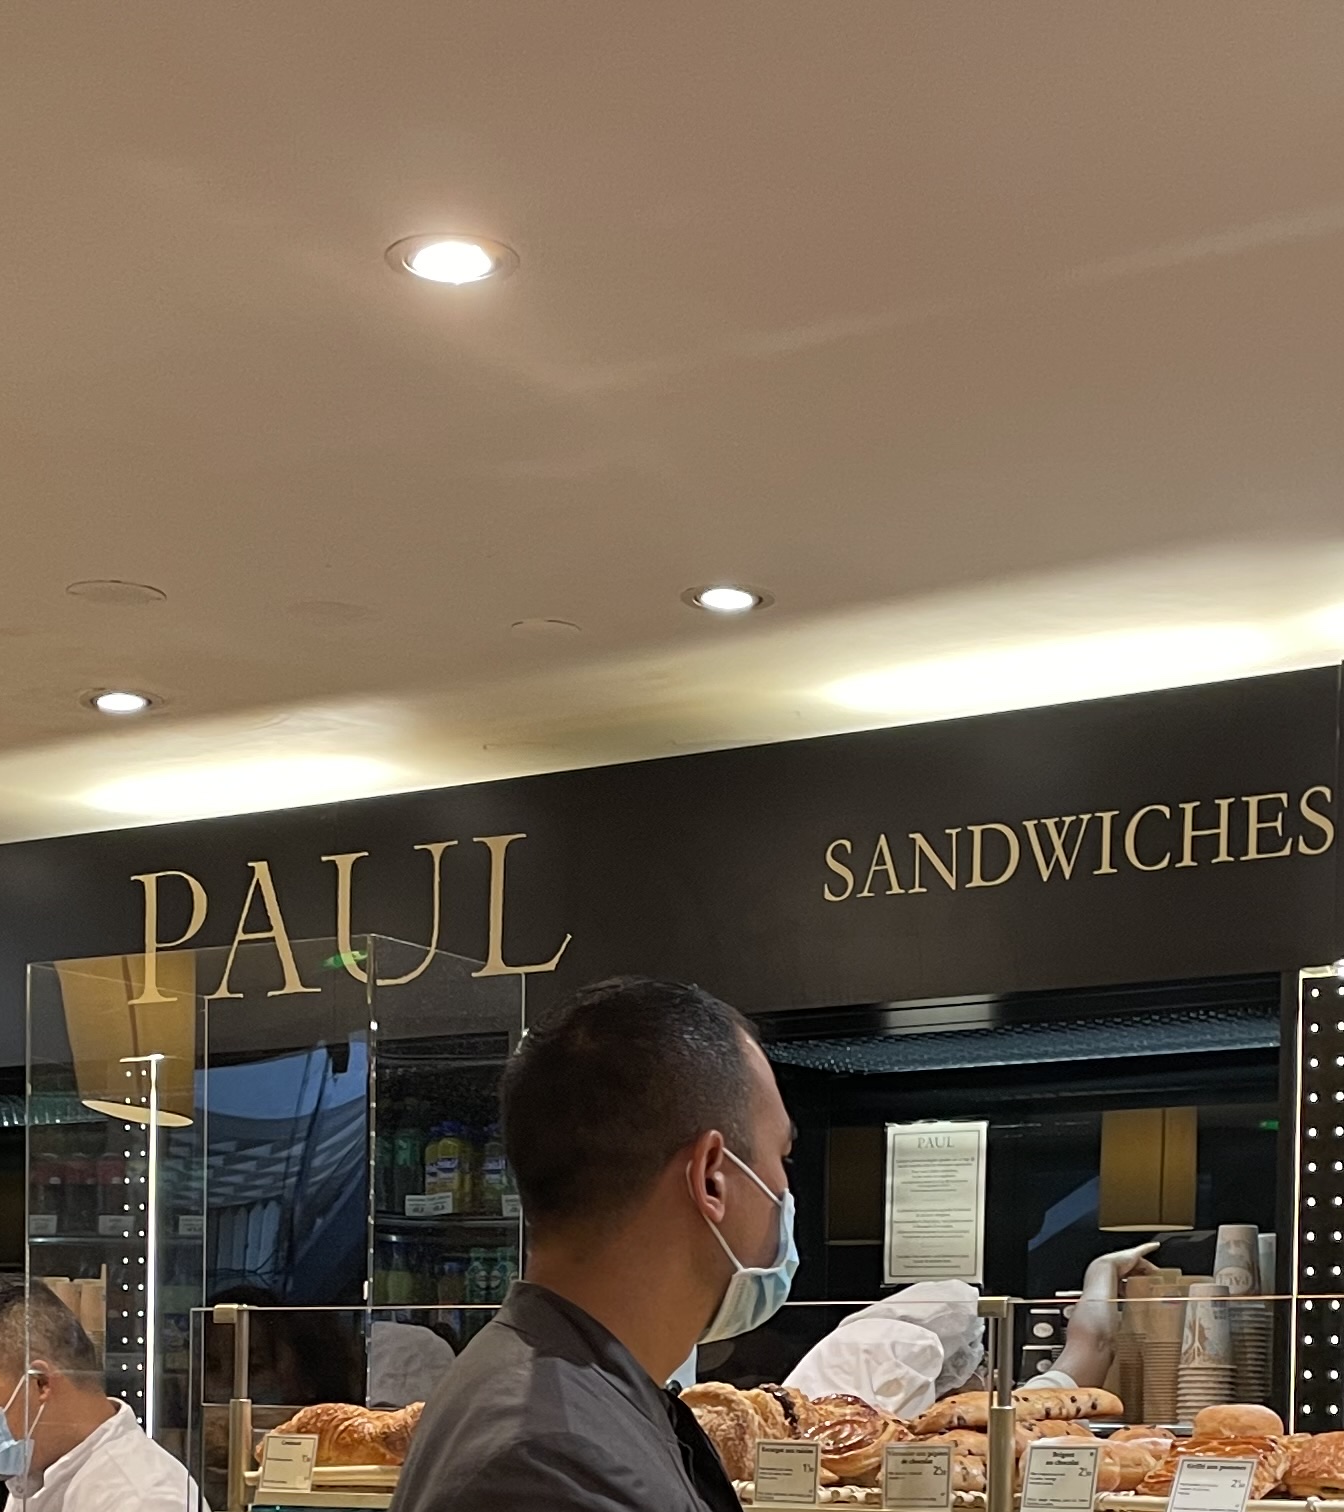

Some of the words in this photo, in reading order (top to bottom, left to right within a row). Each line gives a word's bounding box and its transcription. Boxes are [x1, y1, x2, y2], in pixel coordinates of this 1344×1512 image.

[823, 785, 1336, 902] SANDWICHES
[128, 832, 572, 1006] PAUL
[917, 1136, 954, 1149] PAUL
